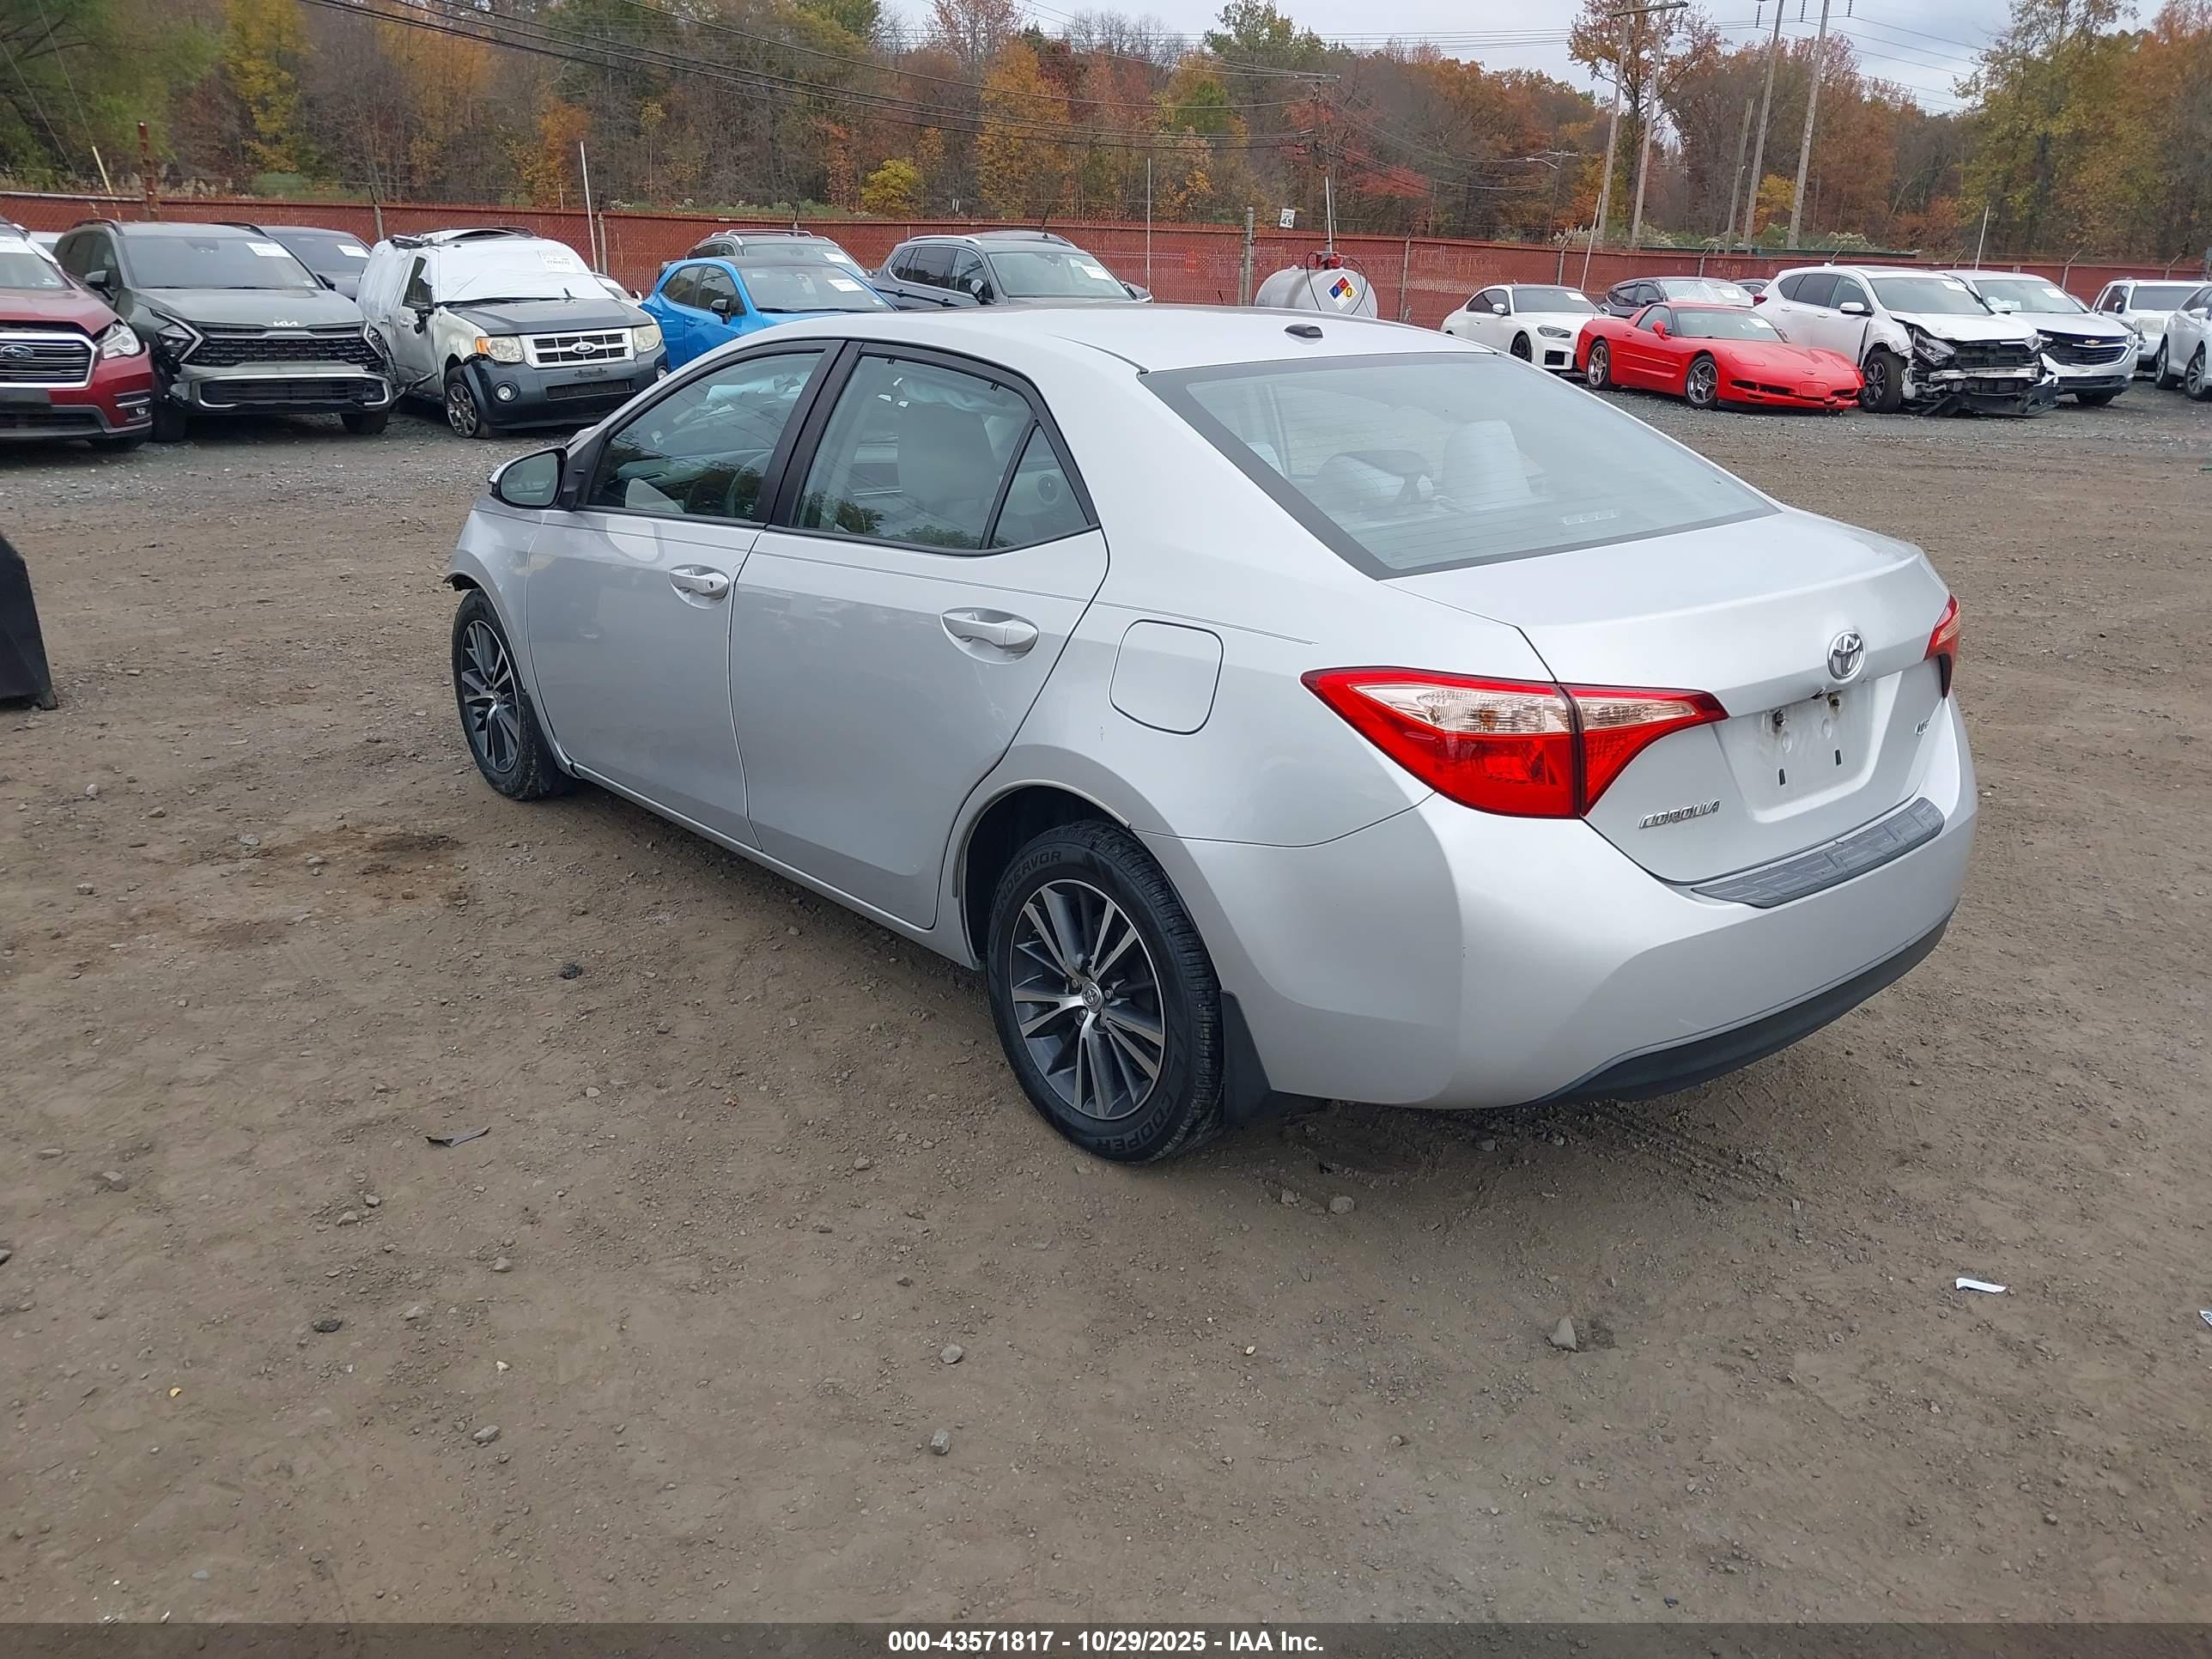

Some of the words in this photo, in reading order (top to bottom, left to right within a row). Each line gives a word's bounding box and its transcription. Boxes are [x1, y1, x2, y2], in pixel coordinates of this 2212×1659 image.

[1281, 217, 1292, 226] 45
[1339, 279, 1347, 289] 2
[1346, 287, 1352, 298] 0
[1638, 799, 1720, 829] COROLLA
[1097, 1092, 1173, 1152] COOPER
